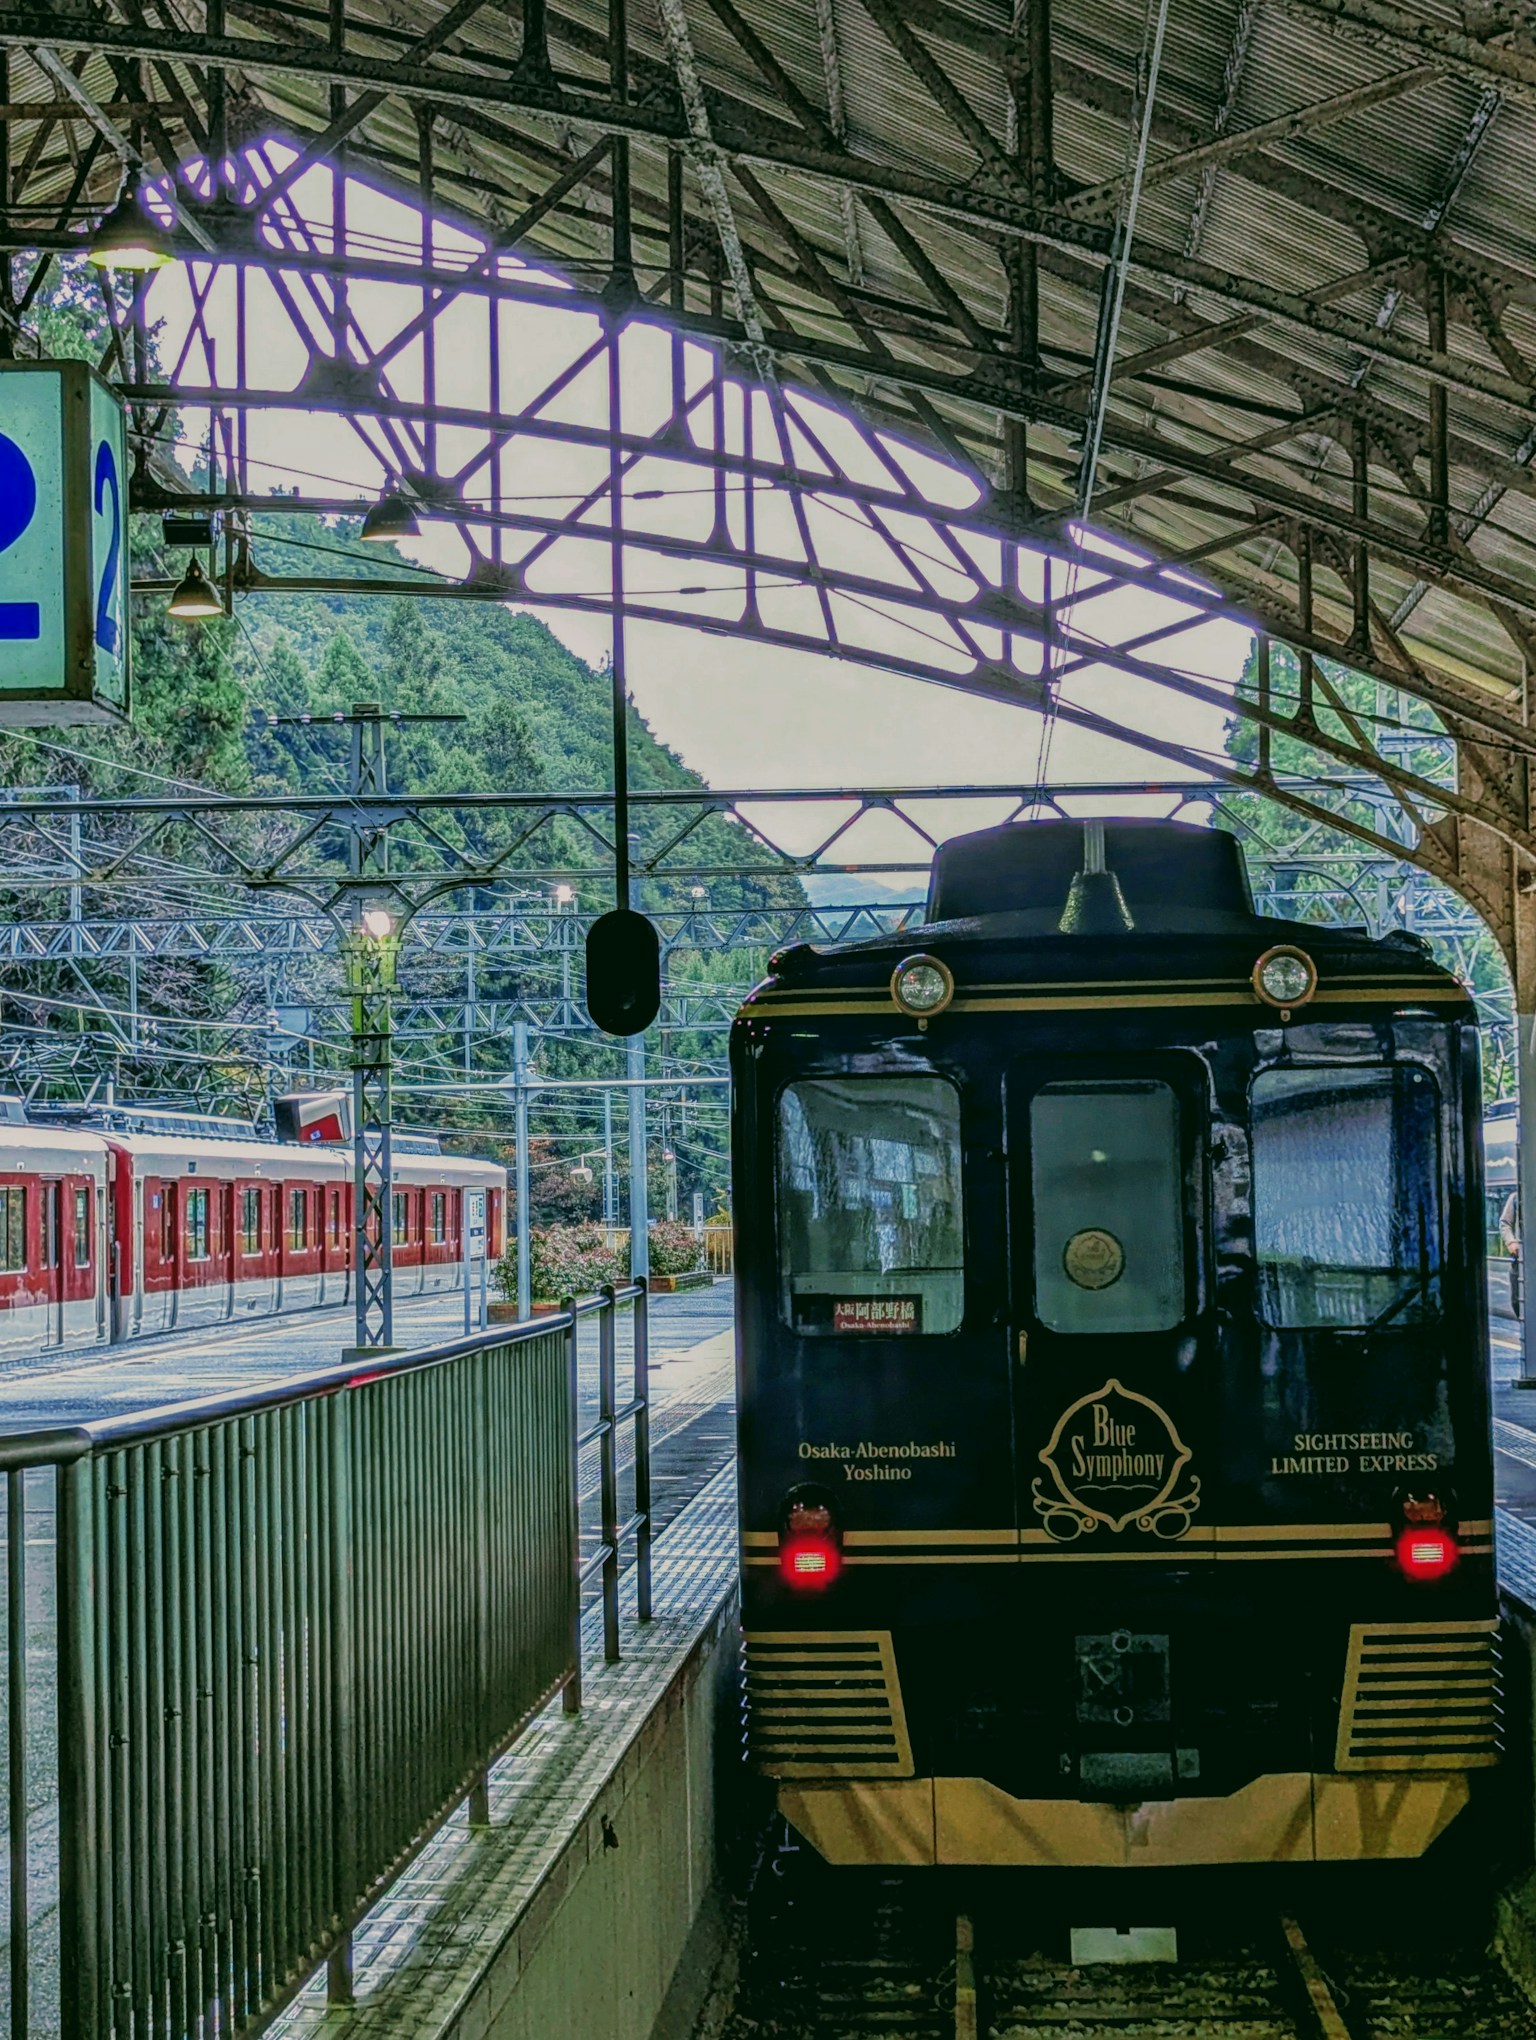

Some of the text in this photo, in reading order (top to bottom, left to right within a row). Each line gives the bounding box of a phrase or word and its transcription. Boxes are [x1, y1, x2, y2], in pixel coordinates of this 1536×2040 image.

[94, 440, 123, 661] 2
[835, 1302, 915, 1320] 大阪阿部野橋
[1092, 1404, 1136, 1447] Blue
[799, 1441, 956, 1459] Osaka-Abenobashi
[1294, 1432, 1413, 1451] SIGHTSEEING
[1071, 1435, 1164, 1481] Symphony
[1272, 1454, 1437, 1474] LIMITED EXPRESS
[843, 1464, 912, 1480] Yoshino
